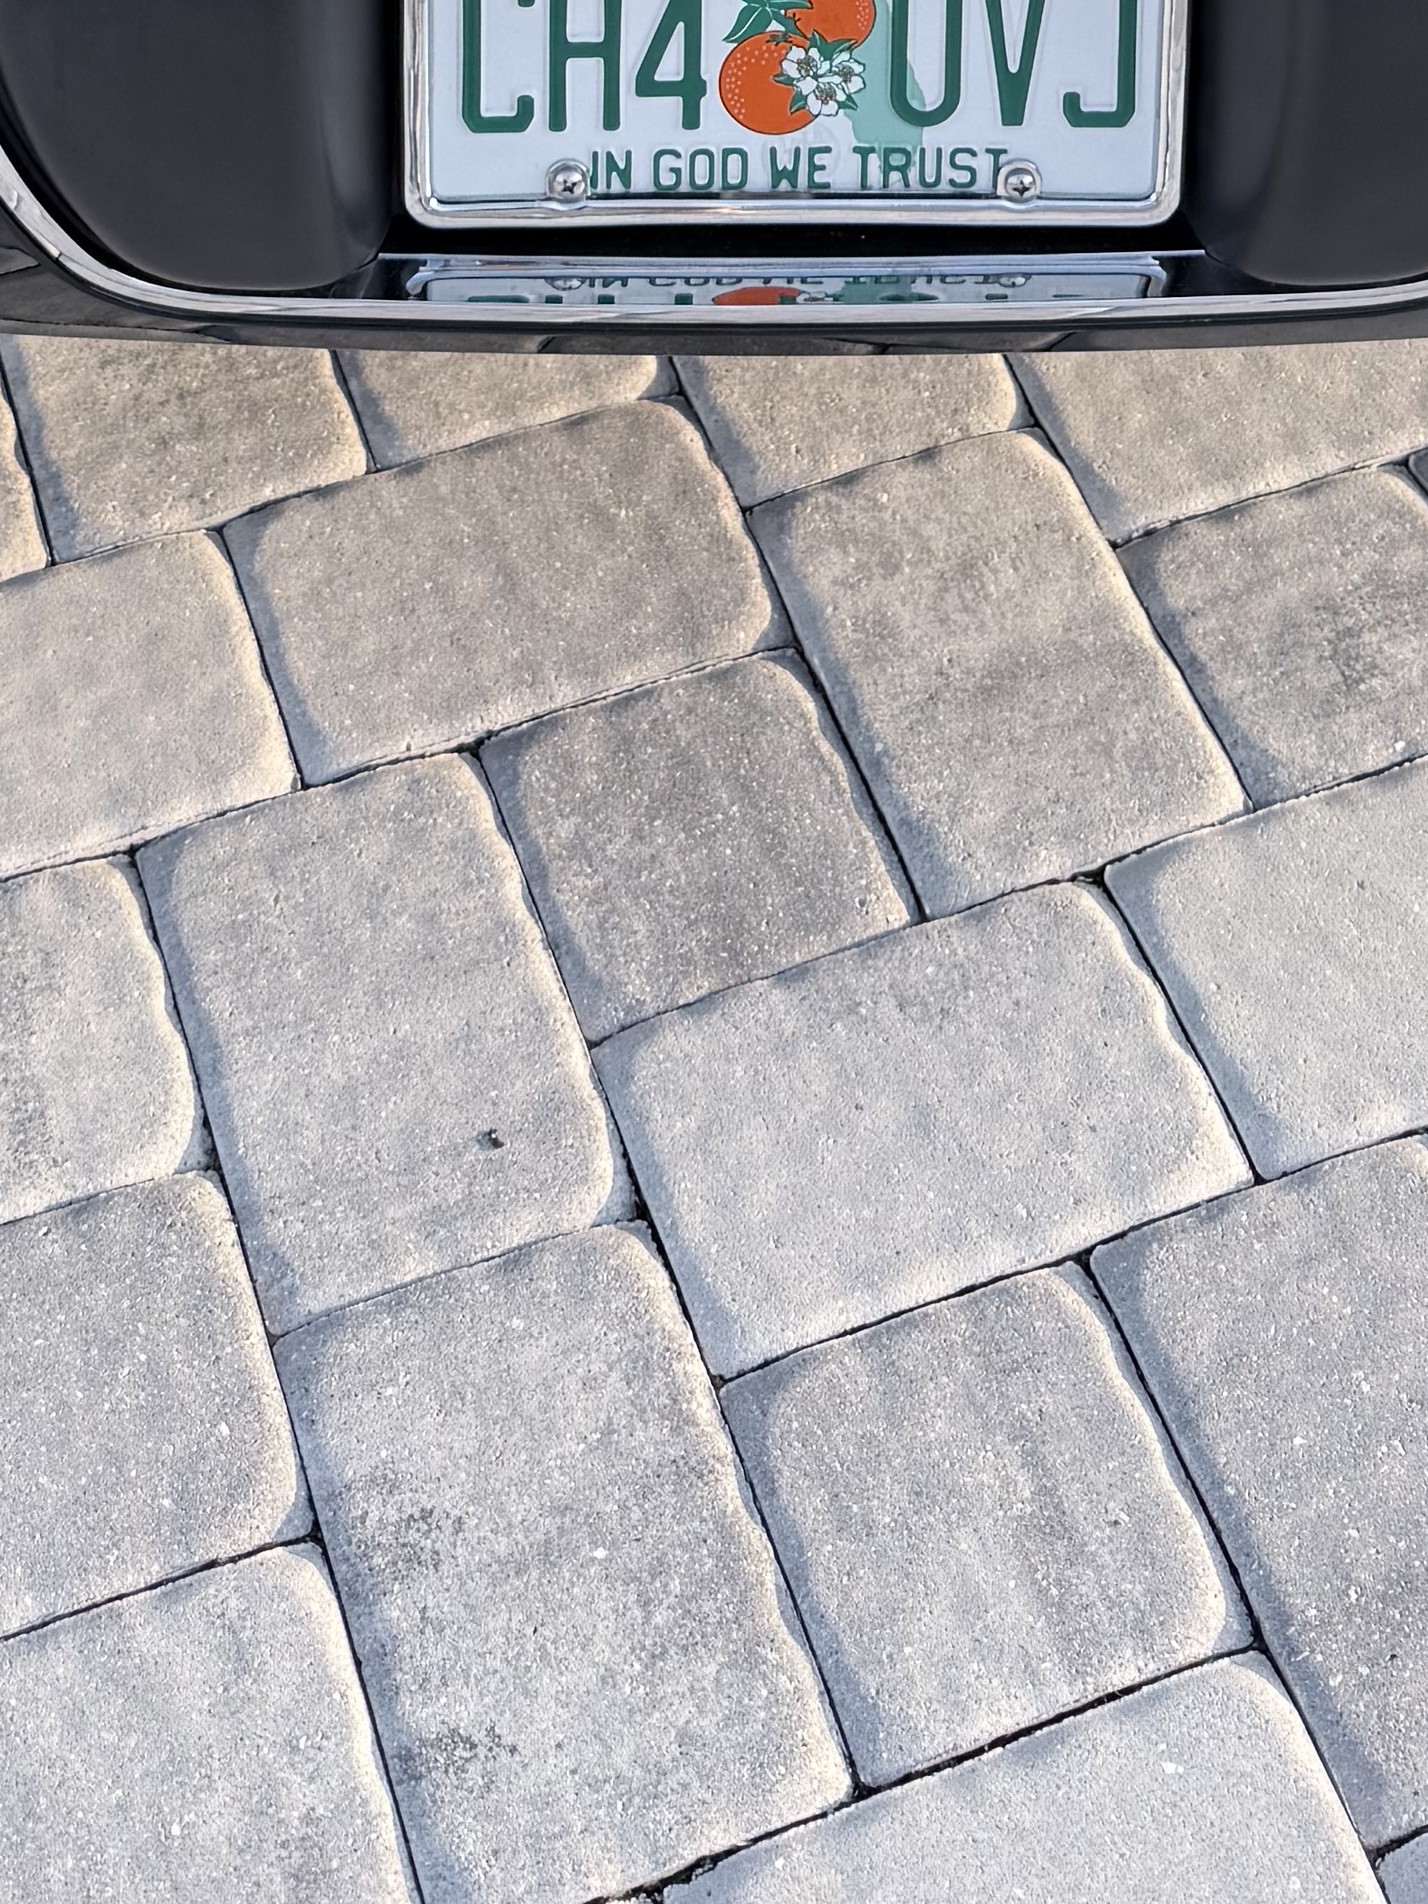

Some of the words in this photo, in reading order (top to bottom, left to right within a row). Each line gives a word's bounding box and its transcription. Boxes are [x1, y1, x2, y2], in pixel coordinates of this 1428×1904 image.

[590, 149, 633, 190] IN
[652, 148, 748, 191] GOD
[769, 145, 832, 189] WE
[853, 145, 1008, 189] TRUST
